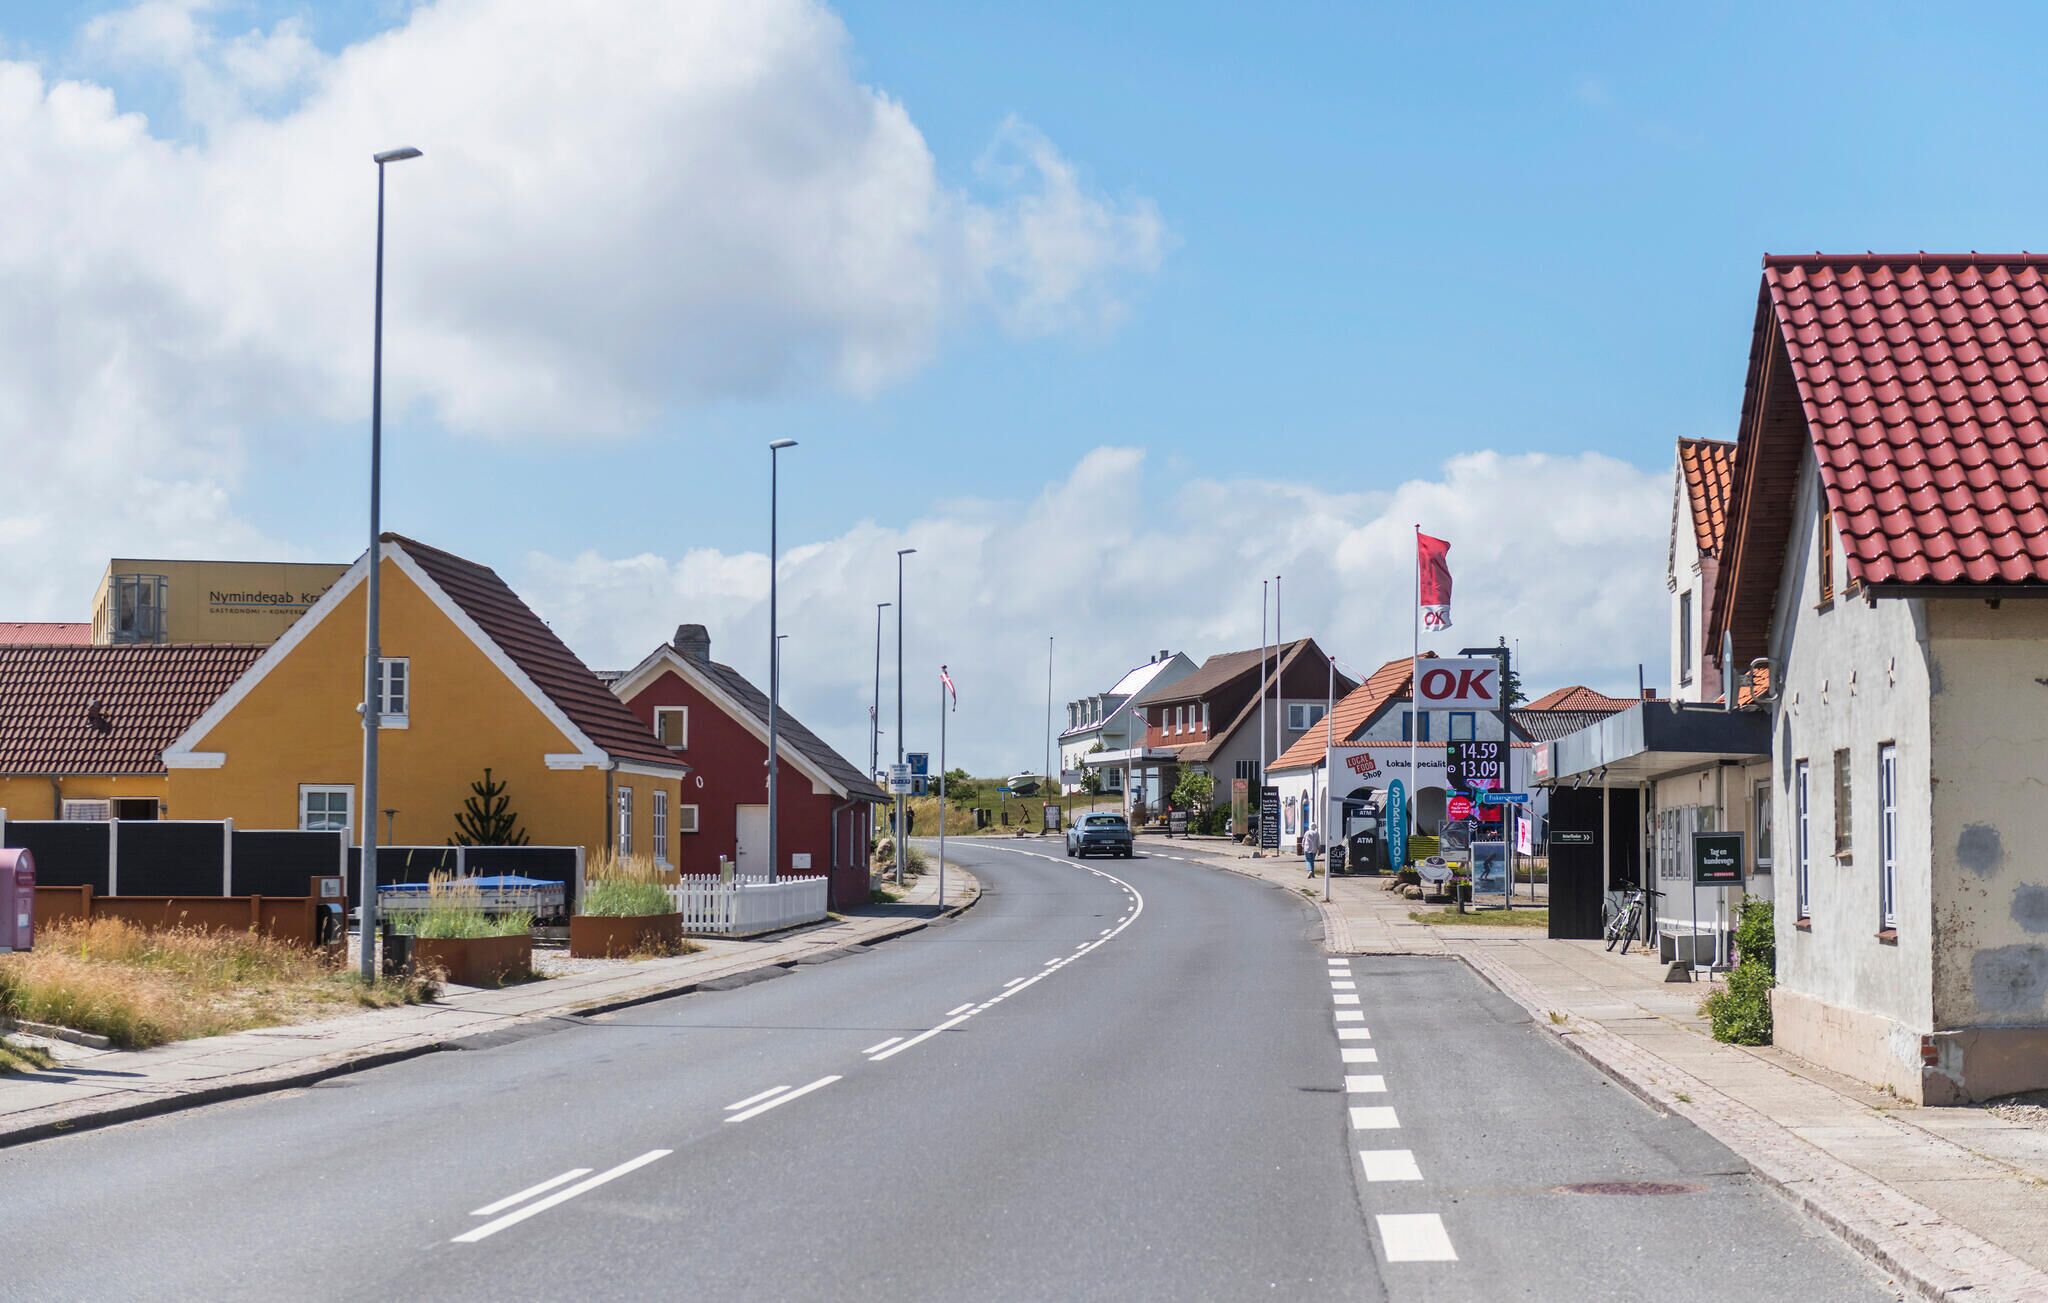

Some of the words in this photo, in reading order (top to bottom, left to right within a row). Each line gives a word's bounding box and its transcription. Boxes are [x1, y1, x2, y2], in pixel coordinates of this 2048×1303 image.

[209, 591, 293, 605] Nymindegab
[1425, 611, 1446, 626] OK
[1420, 668, 1496, 700] OK
[1460, 743, 1498, 759] 14.59
[1348, 753, 1369, 767] LOCAL
[1386, 760, 1412, 768] Lokale
[1417, 760, 1446, 769] pecialit
[1356, 762, 1375, 773] FOOD
[1460, 761, 1498, 777] 13.09
[1363, 770, 1382, 780] Shop
[1392, 787, 1401, 866] SURFSHOP
[1331, 850, 1345, 858] SUP
[1709, 848, 1720, 857] Tag
